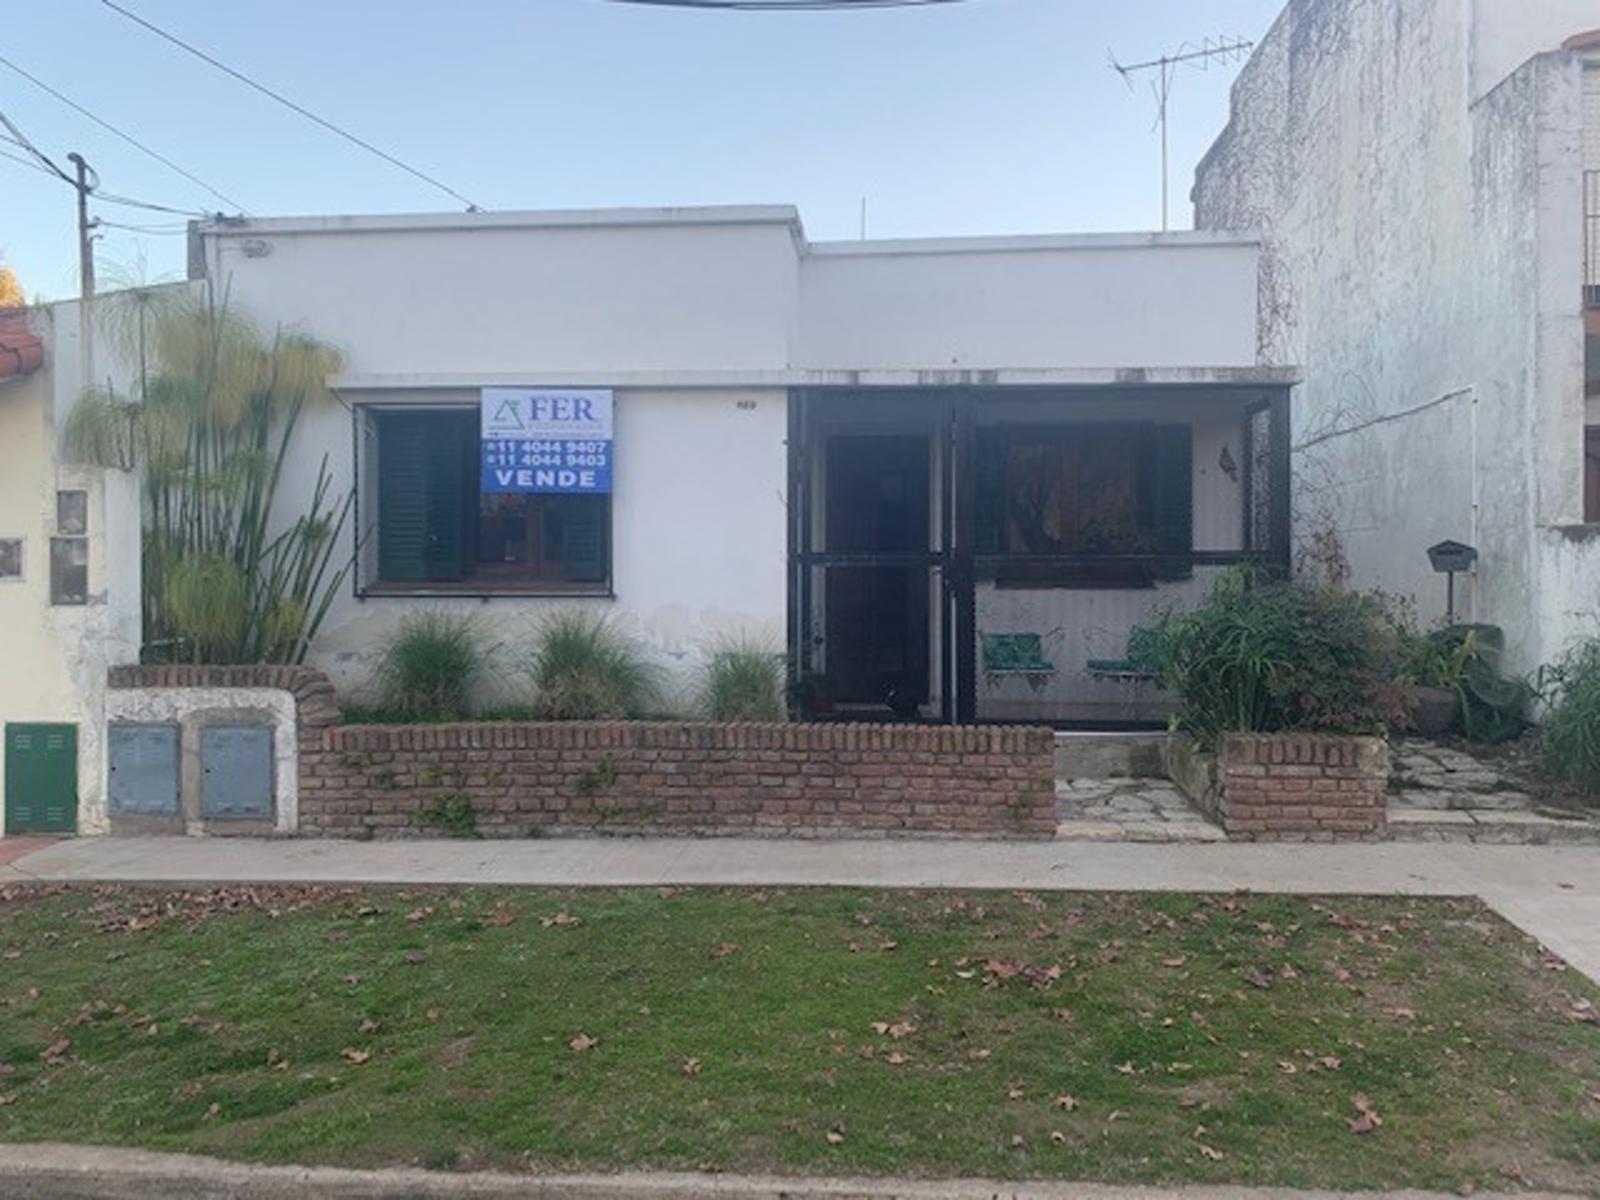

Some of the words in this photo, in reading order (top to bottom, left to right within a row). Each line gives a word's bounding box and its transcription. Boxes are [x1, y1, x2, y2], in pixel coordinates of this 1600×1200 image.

[530, 398, 596, 421] FER
[498, 442, 515, 453] 11
[521, 442, 561, 453] 4044
[566, 442, 606, 453] 9407
[498, 454, 515, 465] 11
[521, 454, 561, 466] 4044
[566, 454, 606, 466] 9403
[495, 469, 596, 487] VENDE
